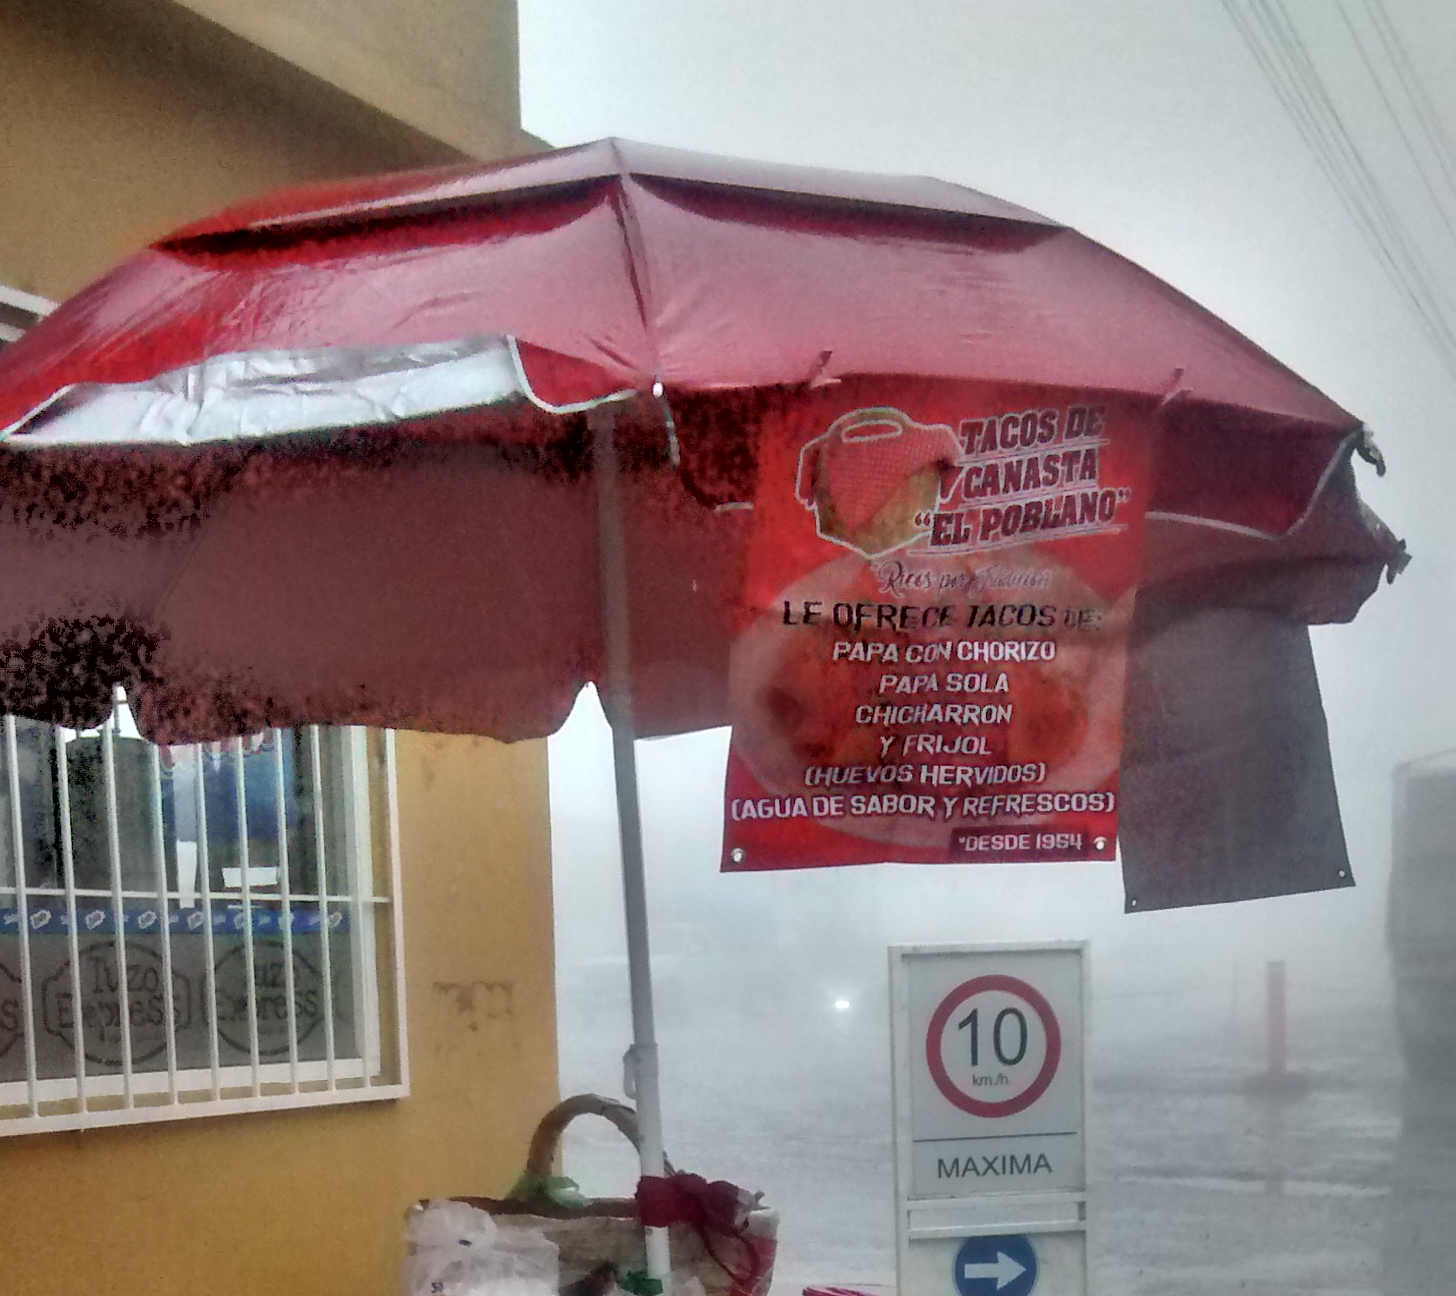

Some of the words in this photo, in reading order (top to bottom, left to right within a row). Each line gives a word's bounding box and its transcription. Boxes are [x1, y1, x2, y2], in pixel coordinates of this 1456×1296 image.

[960, 409, 1058, 456] TACOS
[1064, 405, 1106, 440] DE
[963, 448, 1098, 499] CANASTA
[782, 600, 823, 626] LE
[833, 601, 953, 632] OFRECE
[966, 602, 1057, 630] TACOS
[832, 640, 899, 663] PAPA
[905, 640, 951, 663] CON
[956, 639, 1056, 662] CHORIZO
[879, 673, 939, 695] PAPA
[945, 673, 1009, 694] SOLA
[855, 703, 1013, 726] CHICHARRON
[880, 735, 893, 757] Y
[902, 734, 992, 756] FRIJOL
[804, 764, 914, 787] (HUEVOS
[920, 763, 1046, 787] HERVIDOS)
[731, 796, 807, 821] (AGUA
[813, 796, 844, 817] DE
[850, 794, 936, 817] SABOR
[943, 795, 956, 820] Y
[962, 791, 1115, 818] REFRESCOS)
[957, 1006, 1028, 1068] 10
[937, 1152, 1053, 1180] MAXIMA
